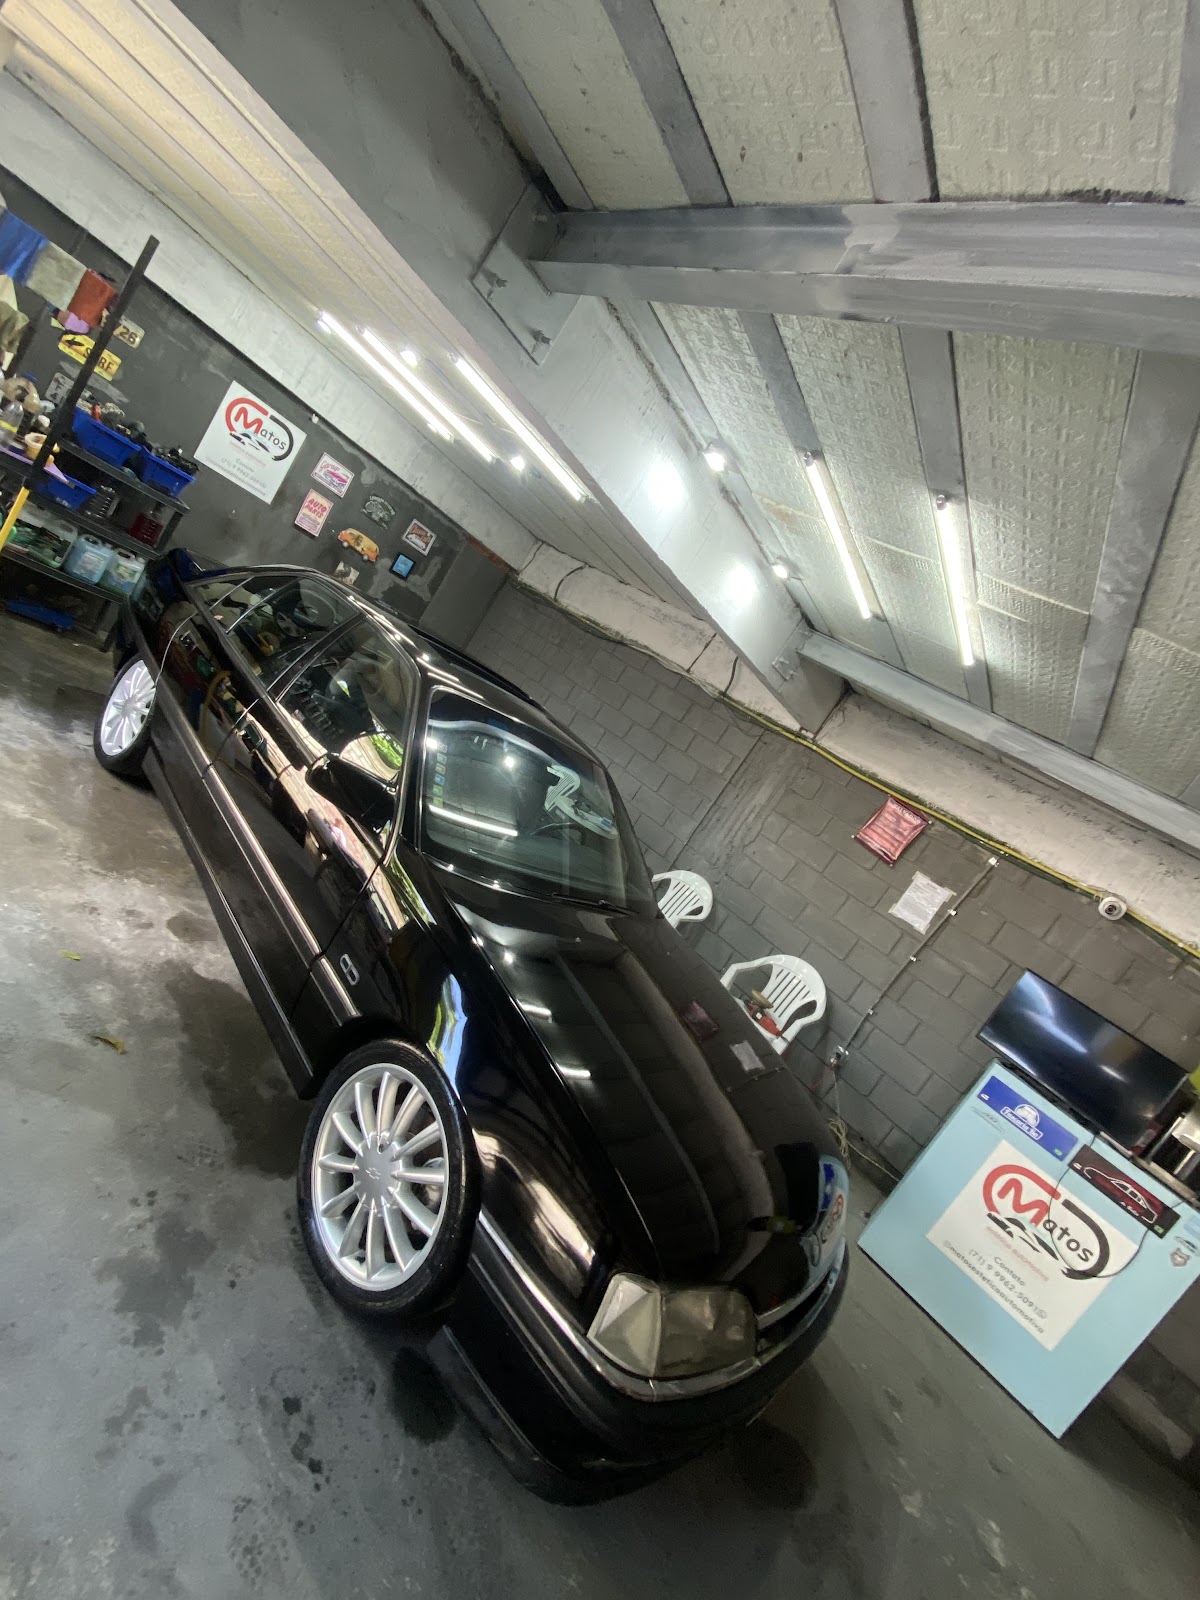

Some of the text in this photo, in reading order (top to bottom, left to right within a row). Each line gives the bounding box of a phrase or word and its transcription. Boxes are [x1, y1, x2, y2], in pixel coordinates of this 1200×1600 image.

[81, 347, 114, 372] SRF
[233, 406, 287, 450] Matos
[304, 503, 323, 517] PARTS
[307, 498, 327, 512] AUTO
[996, 1177, 1094, 1263] Matos
[967, 1247, 986, 1265] (71)
[984, 1263, 993, 1272] 9
[992, 1255, 1026, 1286] Contato
